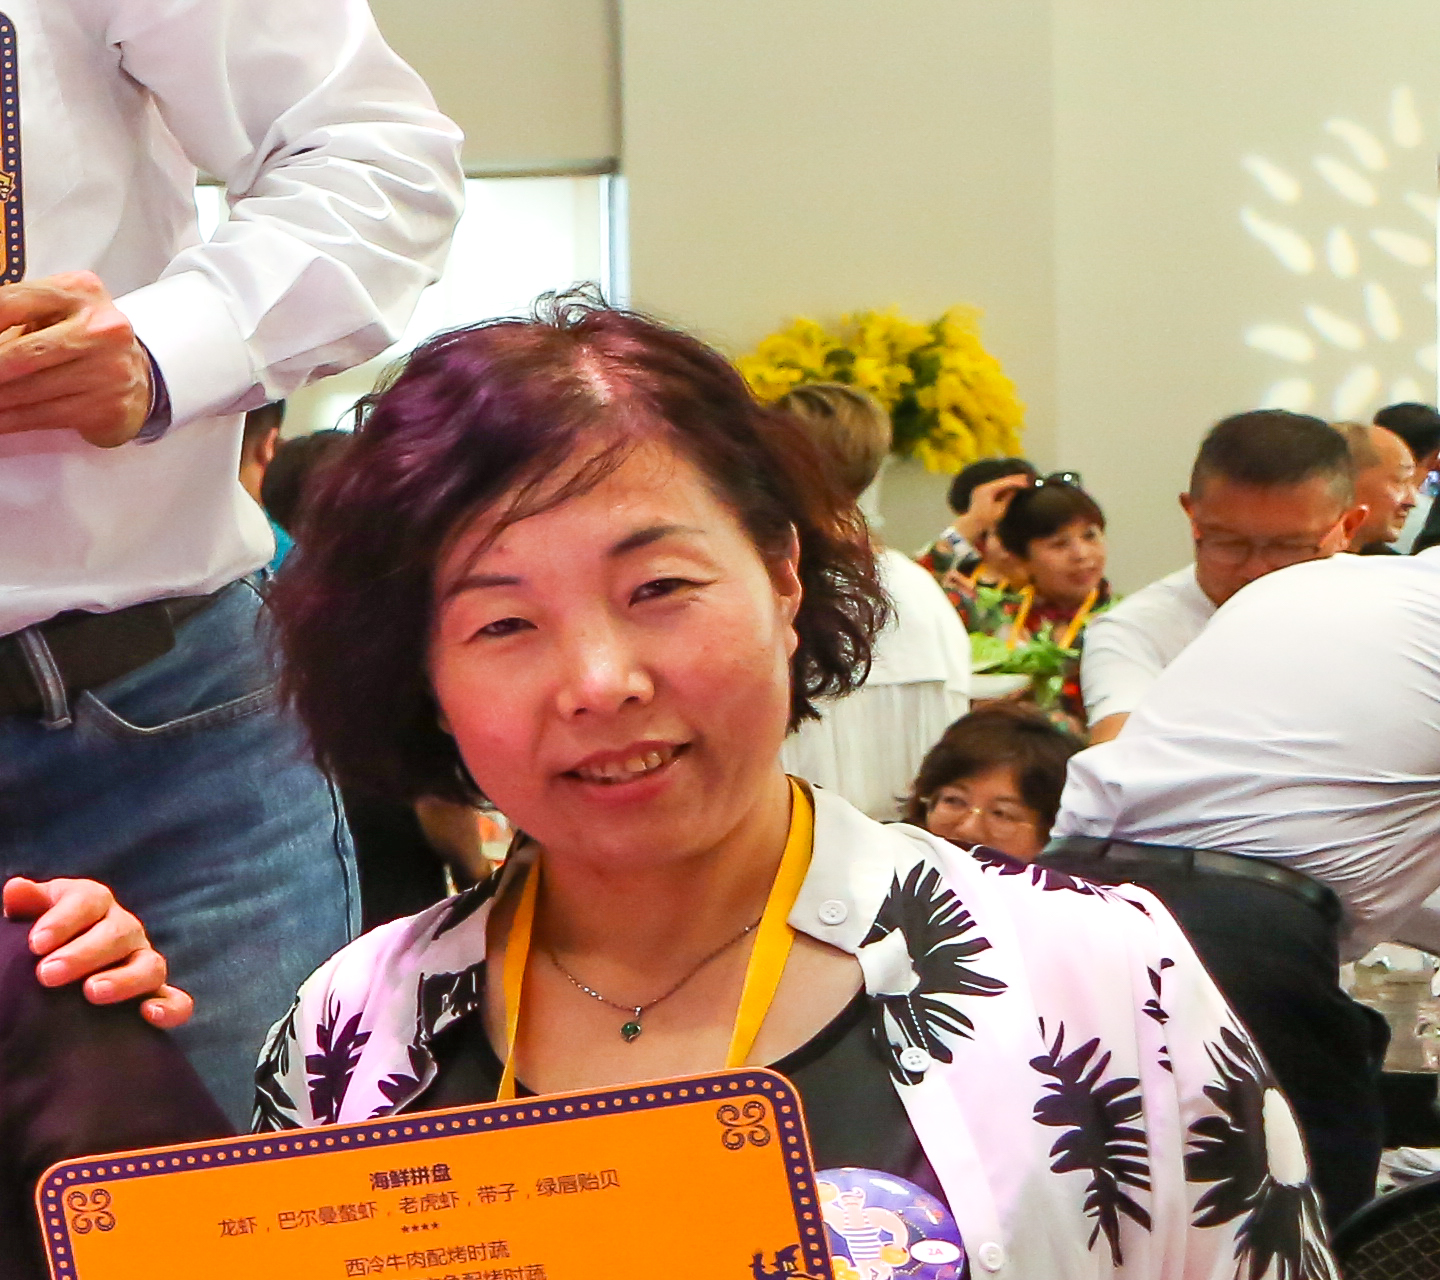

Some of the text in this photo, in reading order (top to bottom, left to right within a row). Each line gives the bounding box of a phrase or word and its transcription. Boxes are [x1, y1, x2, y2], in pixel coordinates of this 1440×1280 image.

[368, 1162, 453, 1192] 海鲜拼盘
[344, 1238, 512, 1279] 西冷牛肉配烤时蔬
